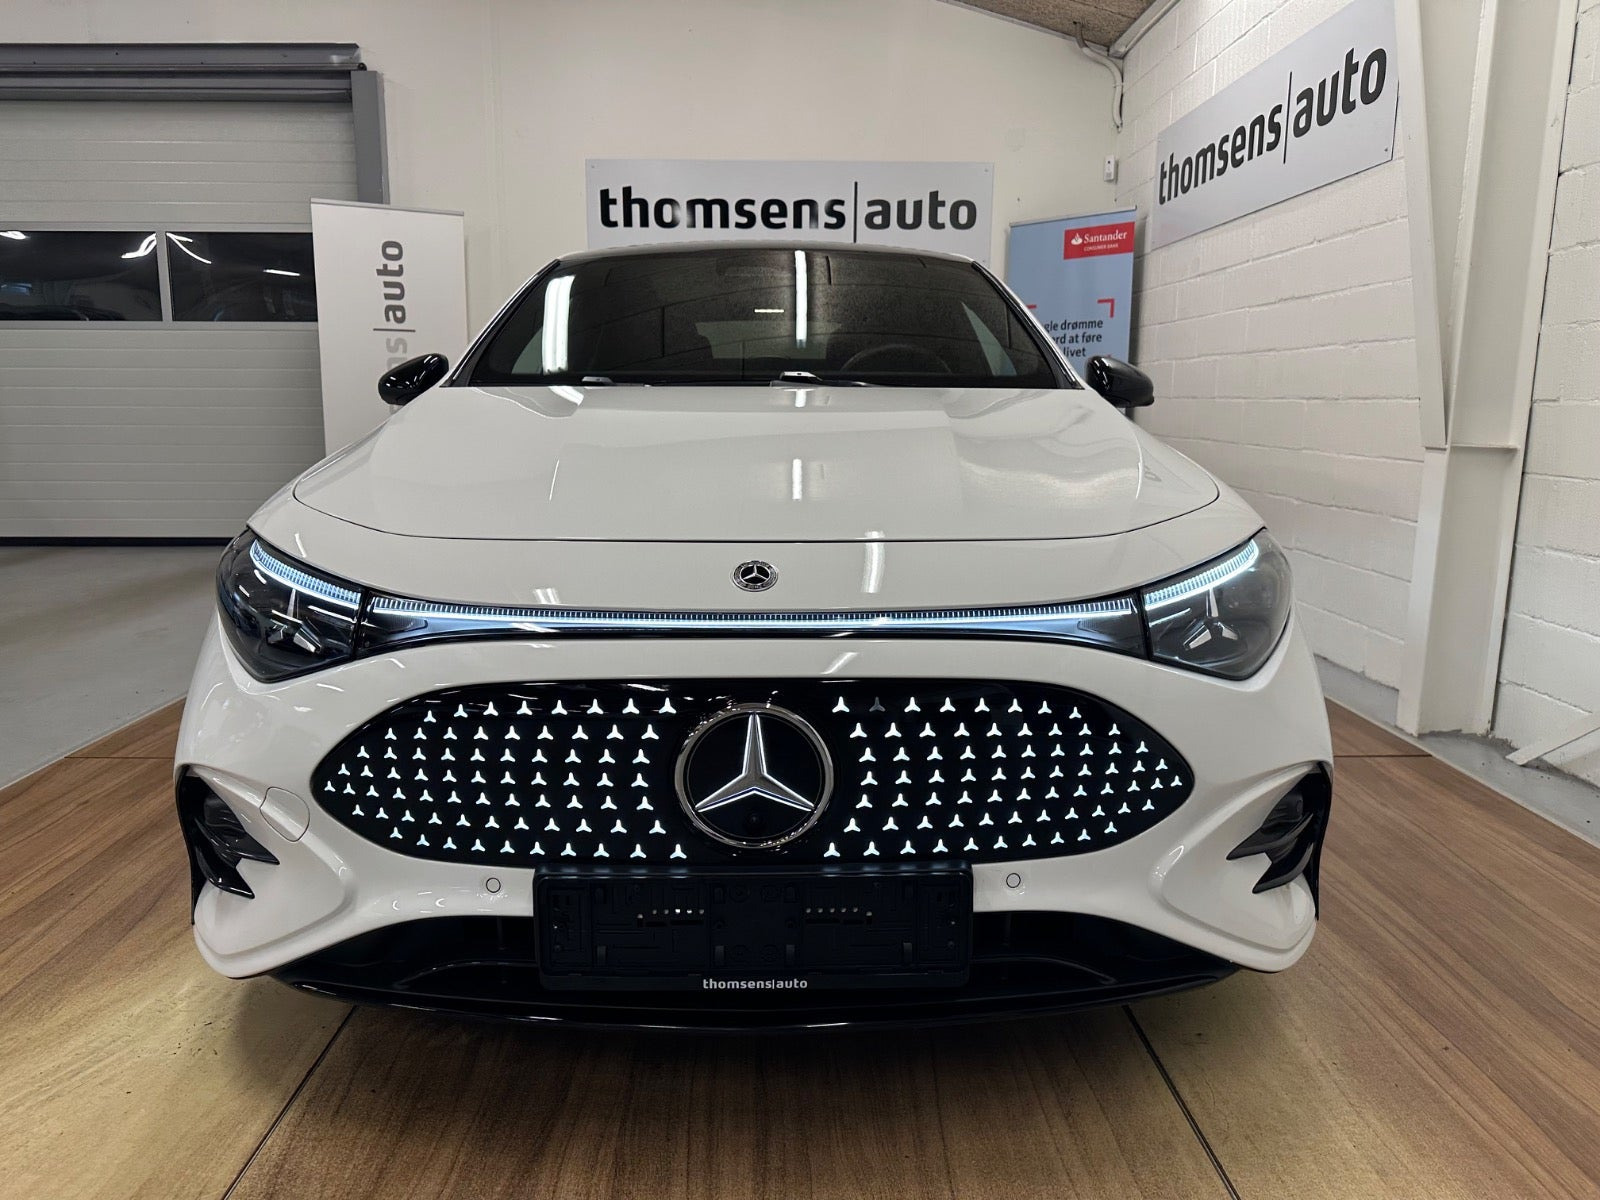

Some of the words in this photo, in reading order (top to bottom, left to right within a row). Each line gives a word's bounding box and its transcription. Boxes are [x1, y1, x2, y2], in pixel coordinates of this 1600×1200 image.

[1083, 229, 1128, 244] Santander
[1043, 320, 1059, 333] gle
[1060, 319, 1104, 331] drømme
[1069, 333, 1080, 344] at
[1081, 331, 1103, 343] føre
[1063, 347, 1087, 357] livet
